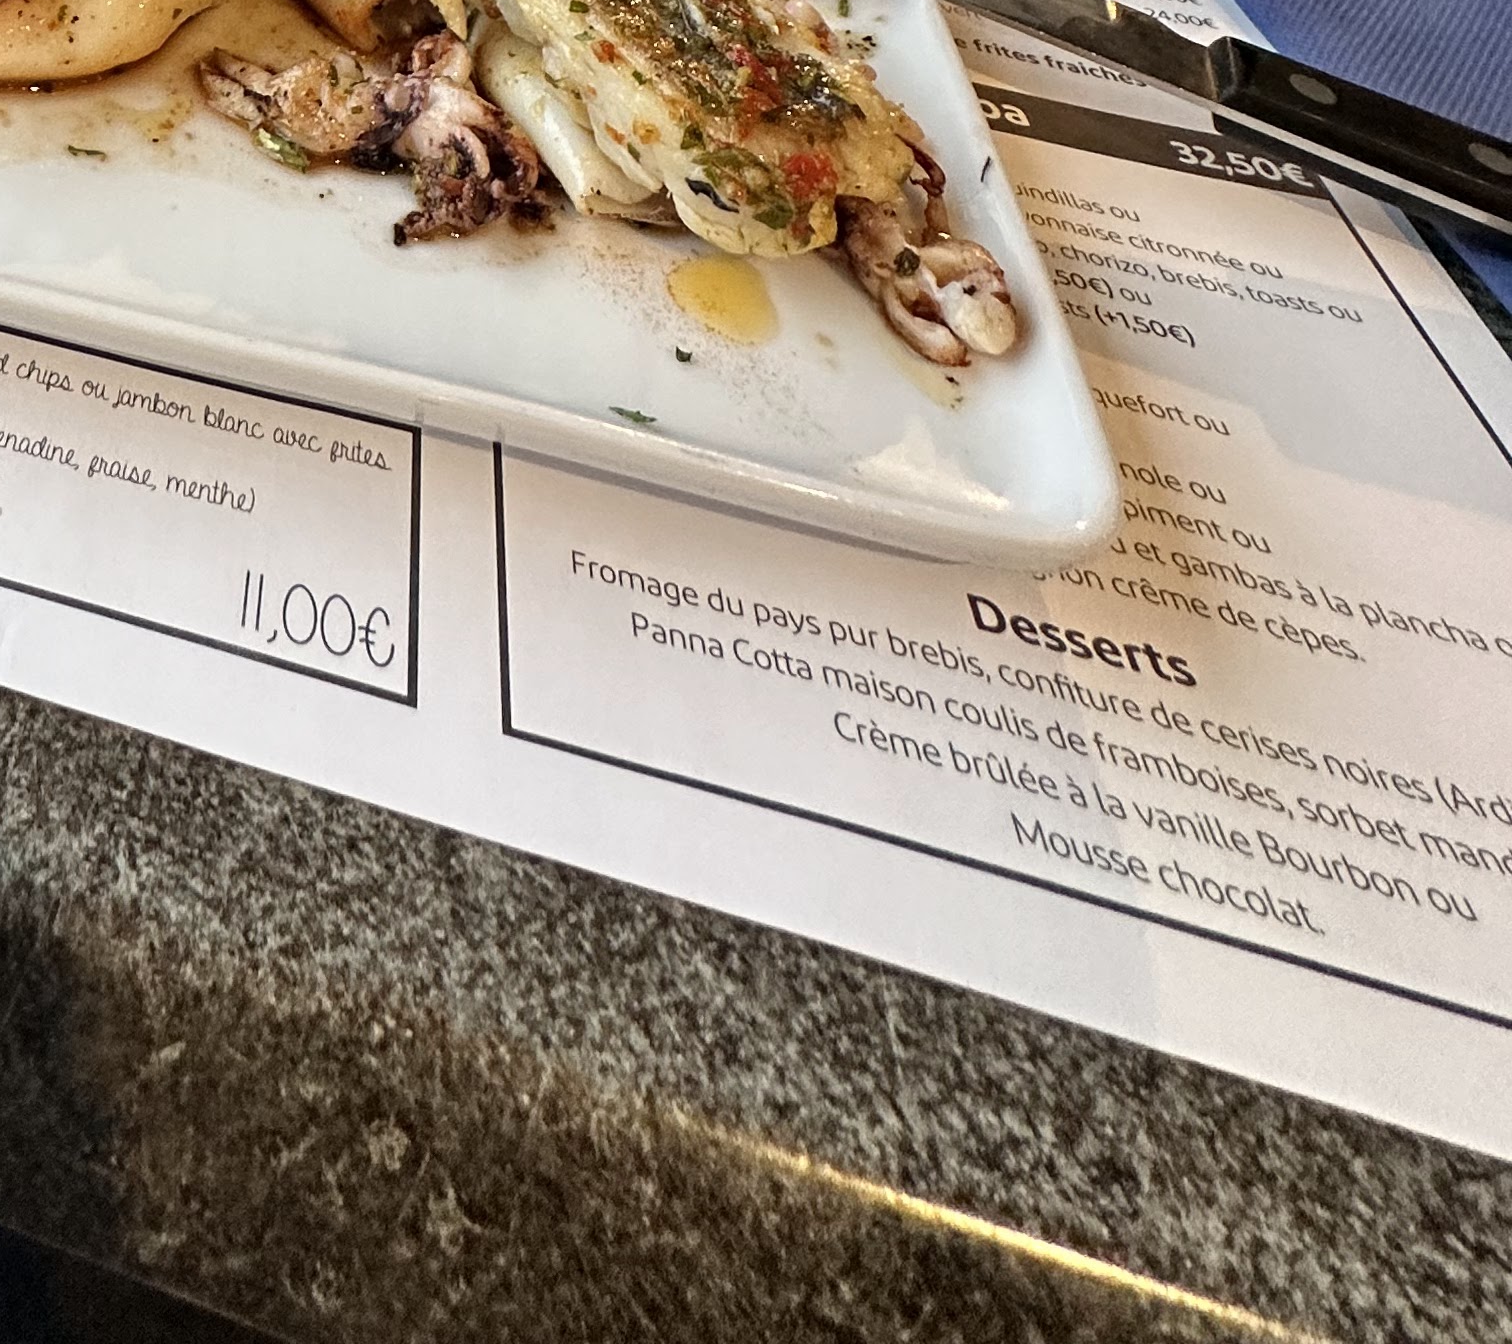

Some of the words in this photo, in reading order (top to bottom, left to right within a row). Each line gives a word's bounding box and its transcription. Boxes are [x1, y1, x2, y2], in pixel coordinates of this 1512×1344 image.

[973, 39, 1040, 65] frites
[1169, 140, 1315, 188] 32,50€
[1110, 206, 1140, 222] ou
[1060, 244, 1156, 282] chorizo,
[1160, 264, 1244, 301] brebis,
[1245, 285, 1325, 316] toasts
[1328, 303, 1363, 324] ou
[1128, 233, 1244, 272] citronnée
[1249, 260, 1284, 280] ou
[1119, 286, 1152, 307] ou
[15, 359, 74, 393] chips
[81, 378, 109, 399] ou
[109, 385, 197, 424] jambon
[203, 405, 265, 440] blanc
[272, 427, 322, 453] avec
[328, 437, 392, 472] frites
[1193, 414, 1231, 436] ou
[86, 455, 157, 493] fraise,
[167, 472, 257, 514] menthe)
[1188, 481, 1227, 505] ou
[1123, 497, 1228, 542] piment
[1232, 527, 1273, 554] ou
[240, 569, 395, 668] 11,00€
[1134, 542, 1167, 566] et
[1171, 552, 1293, 600] gambas
[1294, 576, 1318, 608] à
[1319, 585, 1354, 618] la
[1358, 600, 1490, 652] plancha
[966, 592, 1198, 688] Desserts
[1217, 599, 1259, 633] de
[1264, 615, 1367, 663] cèpes.
[570, 549, 700, 607] Fromage
[707, 587, 745, 617] du
[752, 602, 822, 637] pays
[828, 619, 878, 651] pur
[885, 627, 992, 684] brebis,
[998, 660, 1154, 720] confiture
[1150, 700, 1194, 736] de
[1201, 717, 1319, 772] cerises
[1322, 751, 1435, 806] noires
[630, 611, 725, 659] Panna
[732, 637, 813, 682] Cotta
[822, 664, 937, 714] maison
[943, 697, 1039, 744] coulis
[1046, 725, 1088, 758] de
[1092, 736, 1295, 820] framboises,
[1296, 794, 1416, 853] sorbet
[833, 711, 944, 768] Crème
[949, 741, 1058, 801] brûlée
[1068, 779, 1089, 810] à
[1094, 784, 1128, 821] la
[1132, 798, 1255, 858] vanille
[1261, 829, 1421, 907] Bourbon
[1427, 890, 1480, 923] ou
[1010, 811, 1150, 884] Mousse
[1158, 858, 1328, 938] chocolat.
